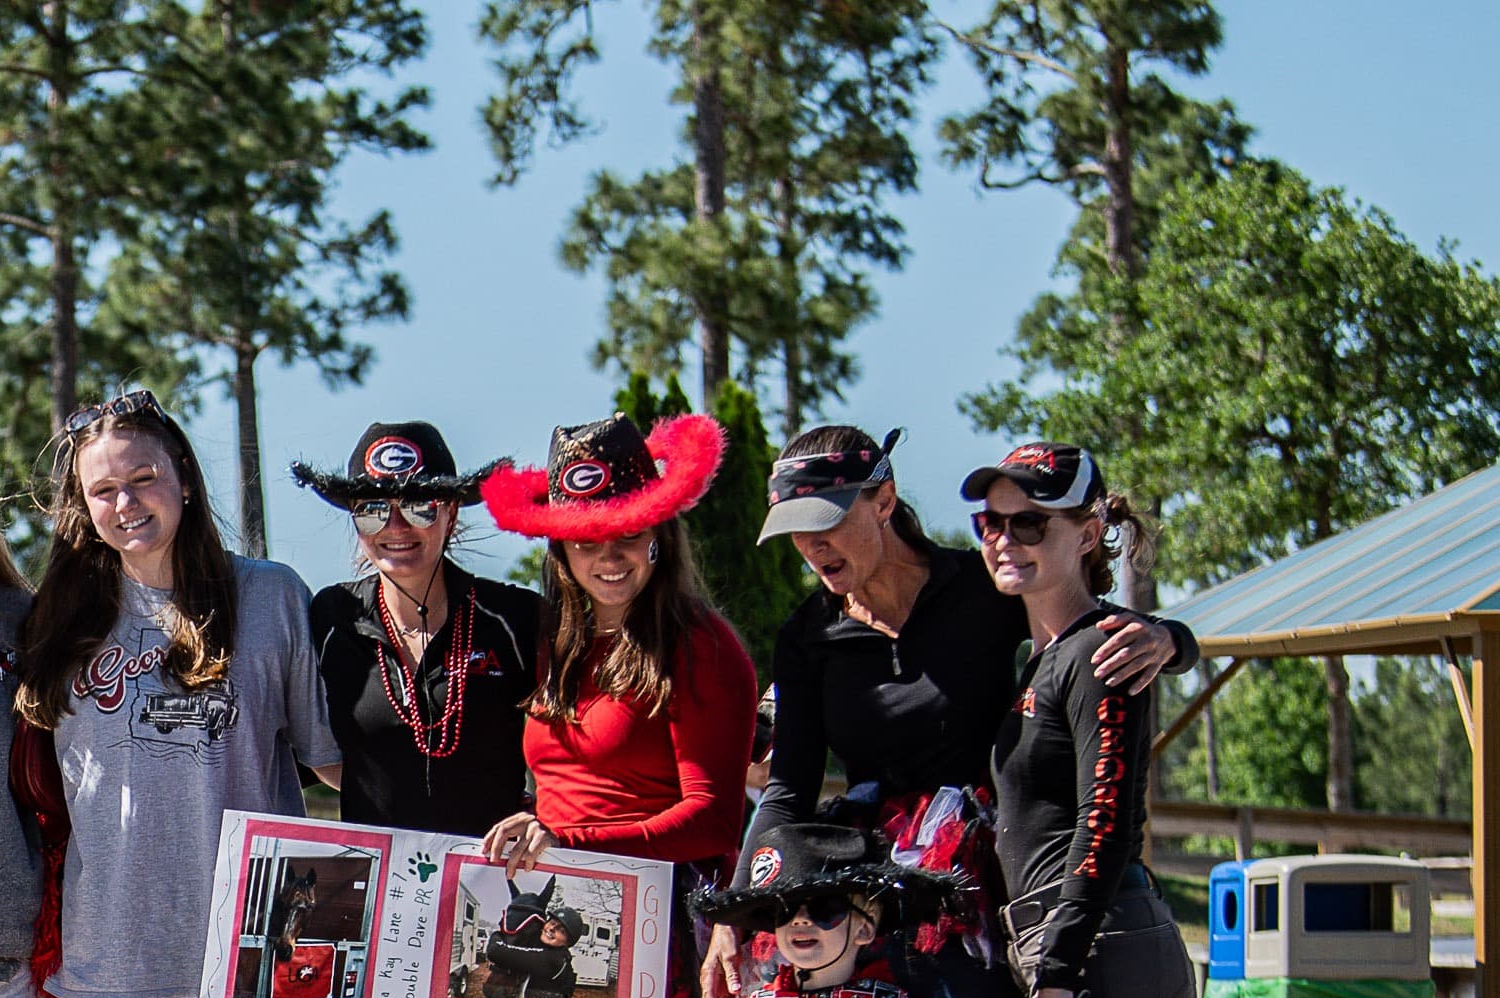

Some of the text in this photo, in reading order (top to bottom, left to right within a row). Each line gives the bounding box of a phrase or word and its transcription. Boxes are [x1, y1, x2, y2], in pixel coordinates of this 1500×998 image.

[379, 444, 418, 468] G
[571, 467, 604, 488] G
[72, 645, 166, 714] Geor
[1072, 696, 1127, 878] GEORGIA
[383, 912, 402, 943] Lane
[641, 885, 659, 945] GO
[378, 956, 402, 979] Kay
